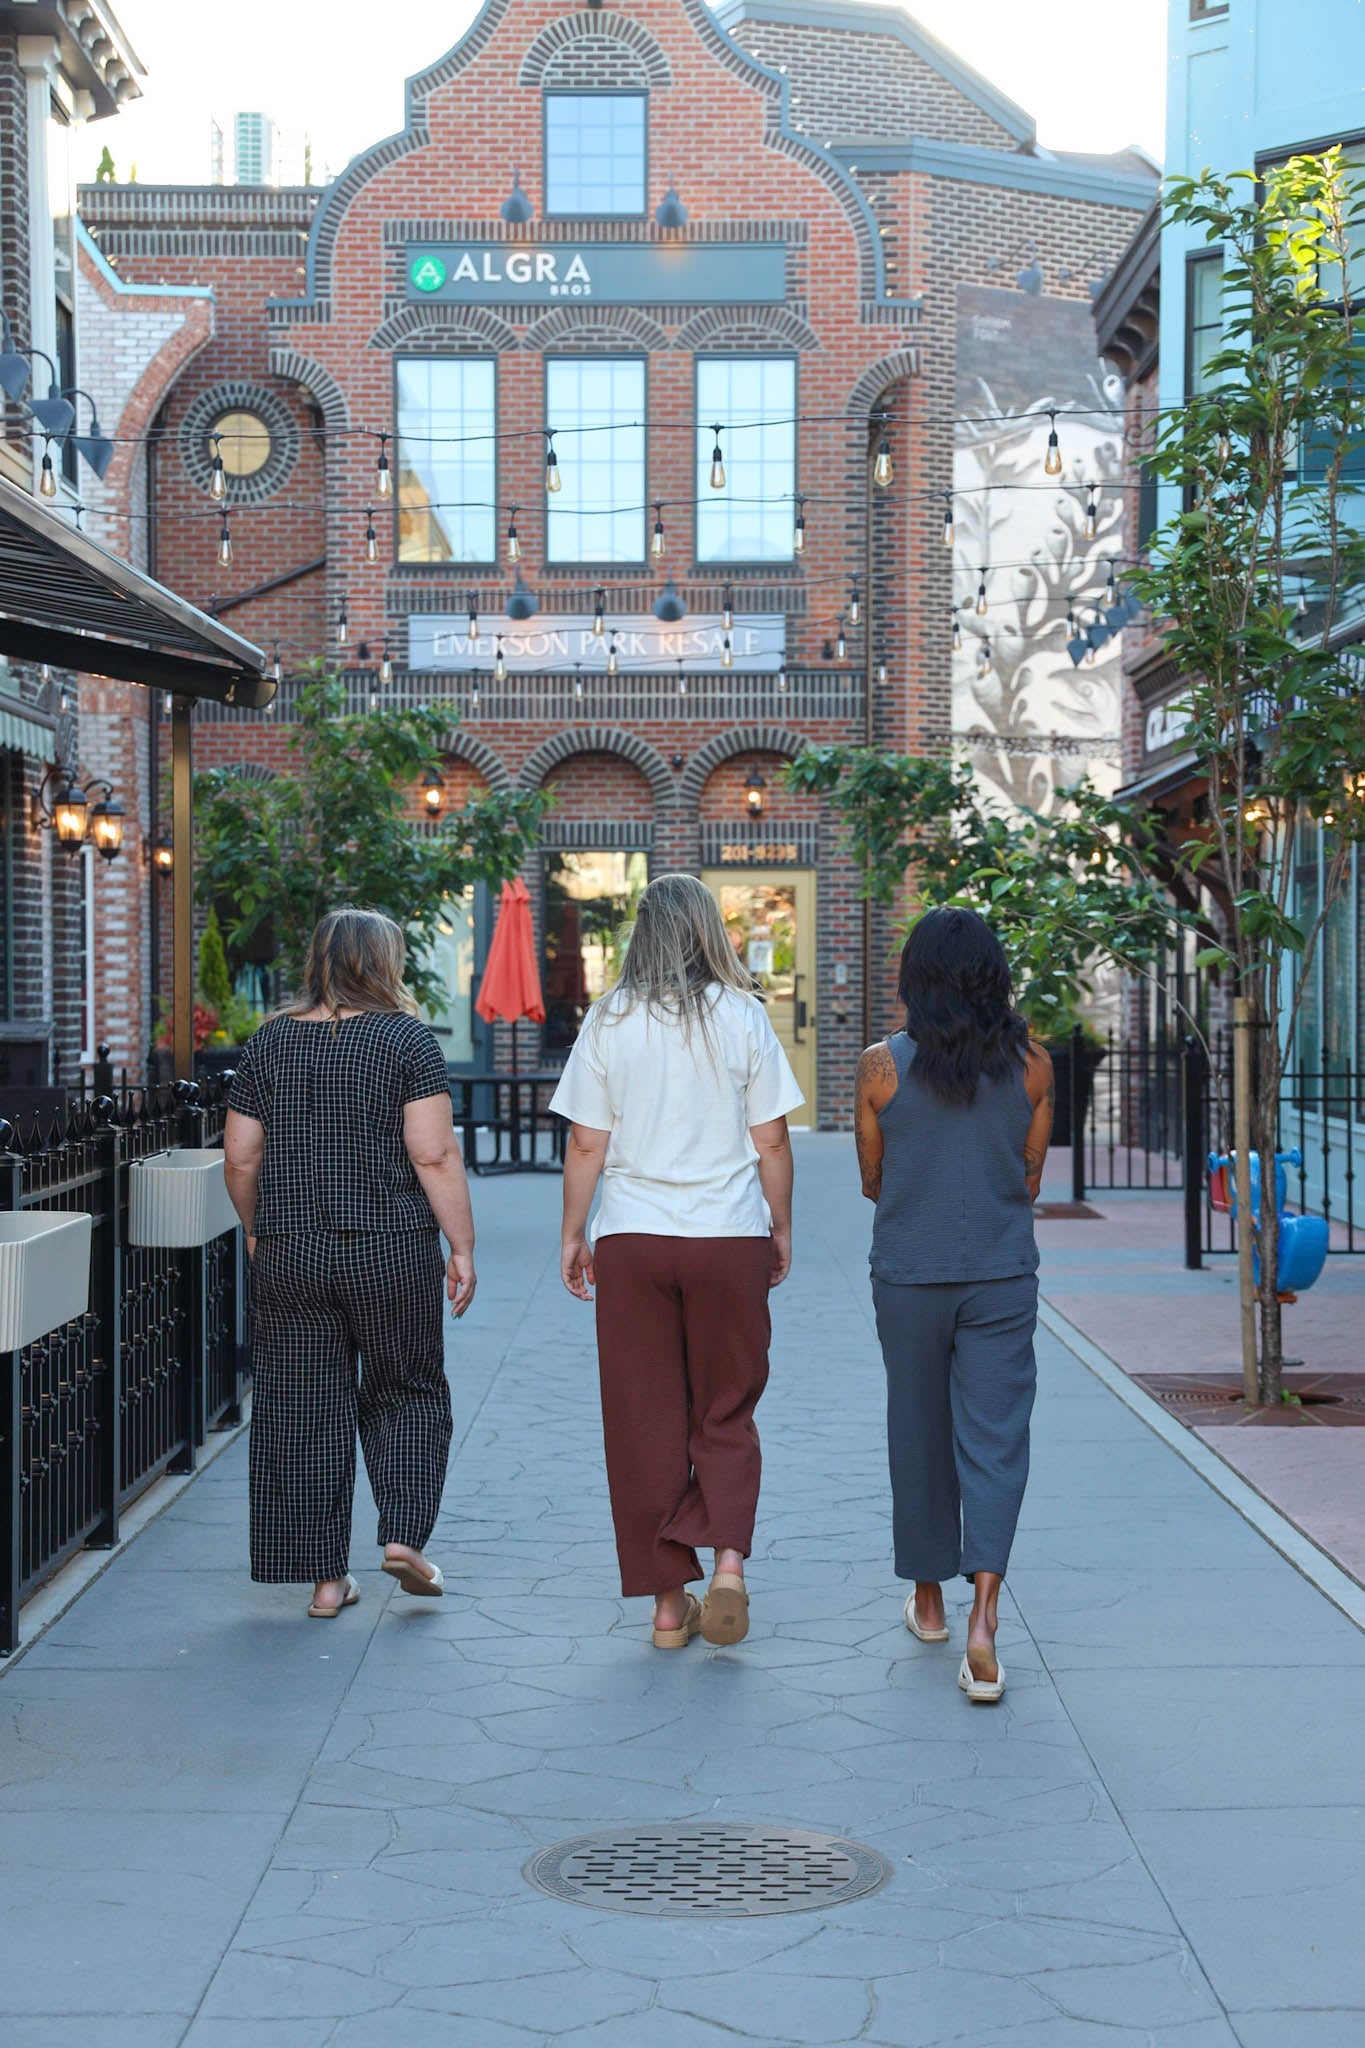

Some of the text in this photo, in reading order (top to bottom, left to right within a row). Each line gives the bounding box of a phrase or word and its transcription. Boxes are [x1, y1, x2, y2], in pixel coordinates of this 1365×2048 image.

[452, 252, 592, 283] ALGRA
[549, 284, 592, 296] BROS
[432, 631, 761, 657] EMERSON PARK RESALE
